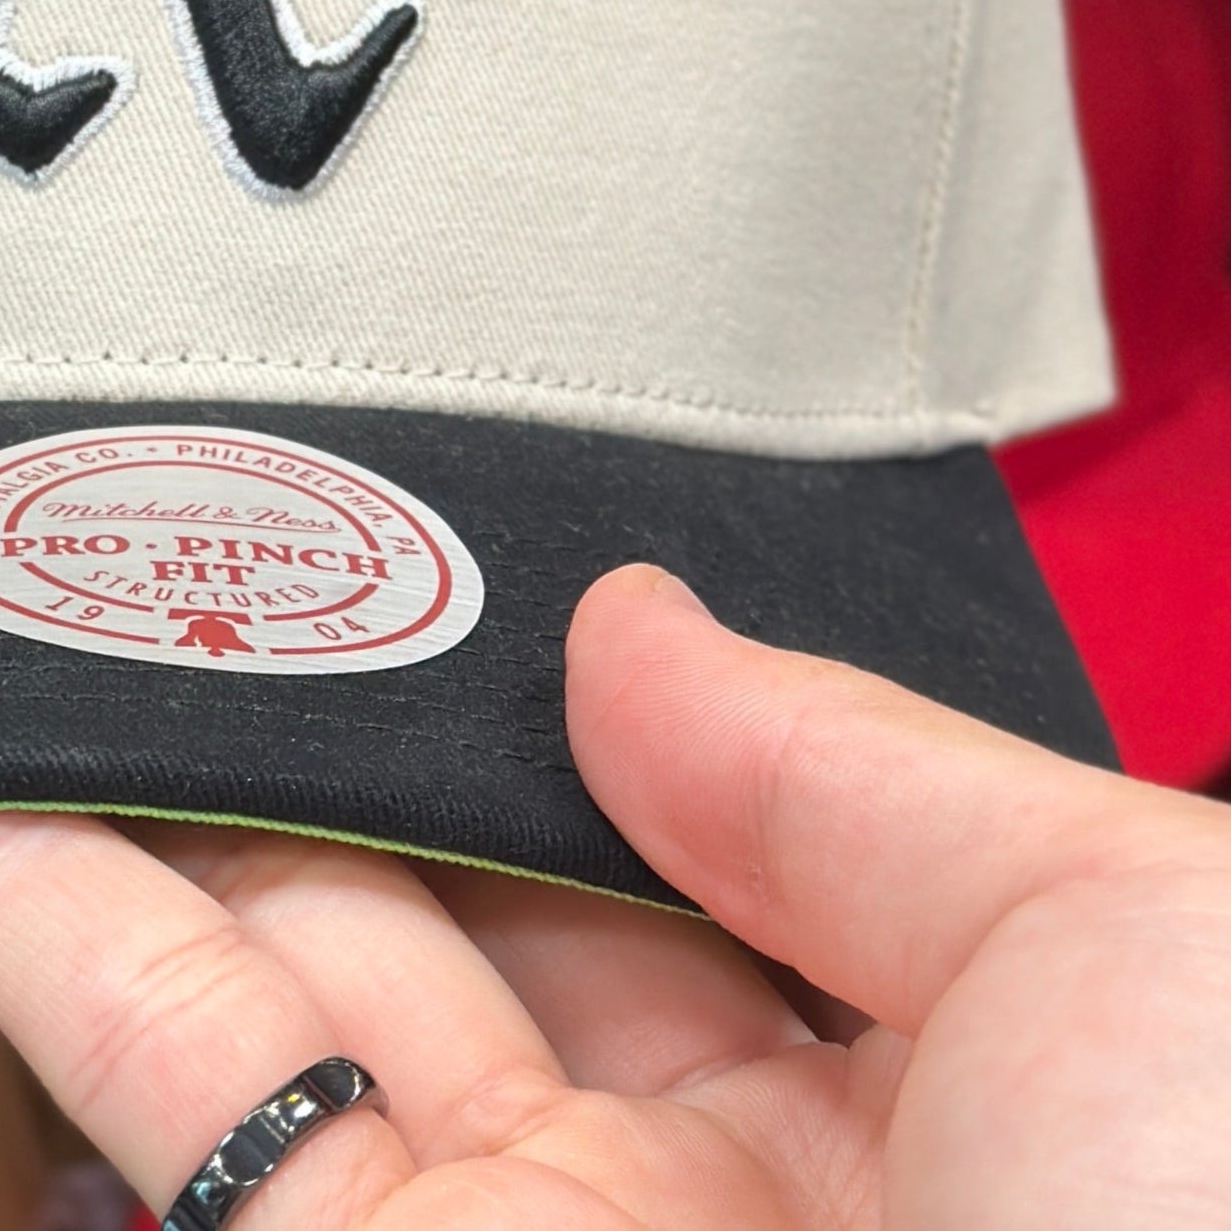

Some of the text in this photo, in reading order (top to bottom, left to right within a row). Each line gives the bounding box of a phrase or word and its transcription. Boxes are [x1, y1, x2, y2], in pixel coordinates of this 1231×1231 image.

[42, 500, 339, 531] Mitchell & Ness
[74, 447, 134, 464] CO.
[176, 443, 393, 528] PHILADELPHIA,
[385, 535, 422, 556] PA
[0, 534, 393, 581] PRO PINCH
[149, 560, 256, 587] FIT
[82, 569, 320, 608] STRUCTURED
[44, 595, 371, 641] 19 04
